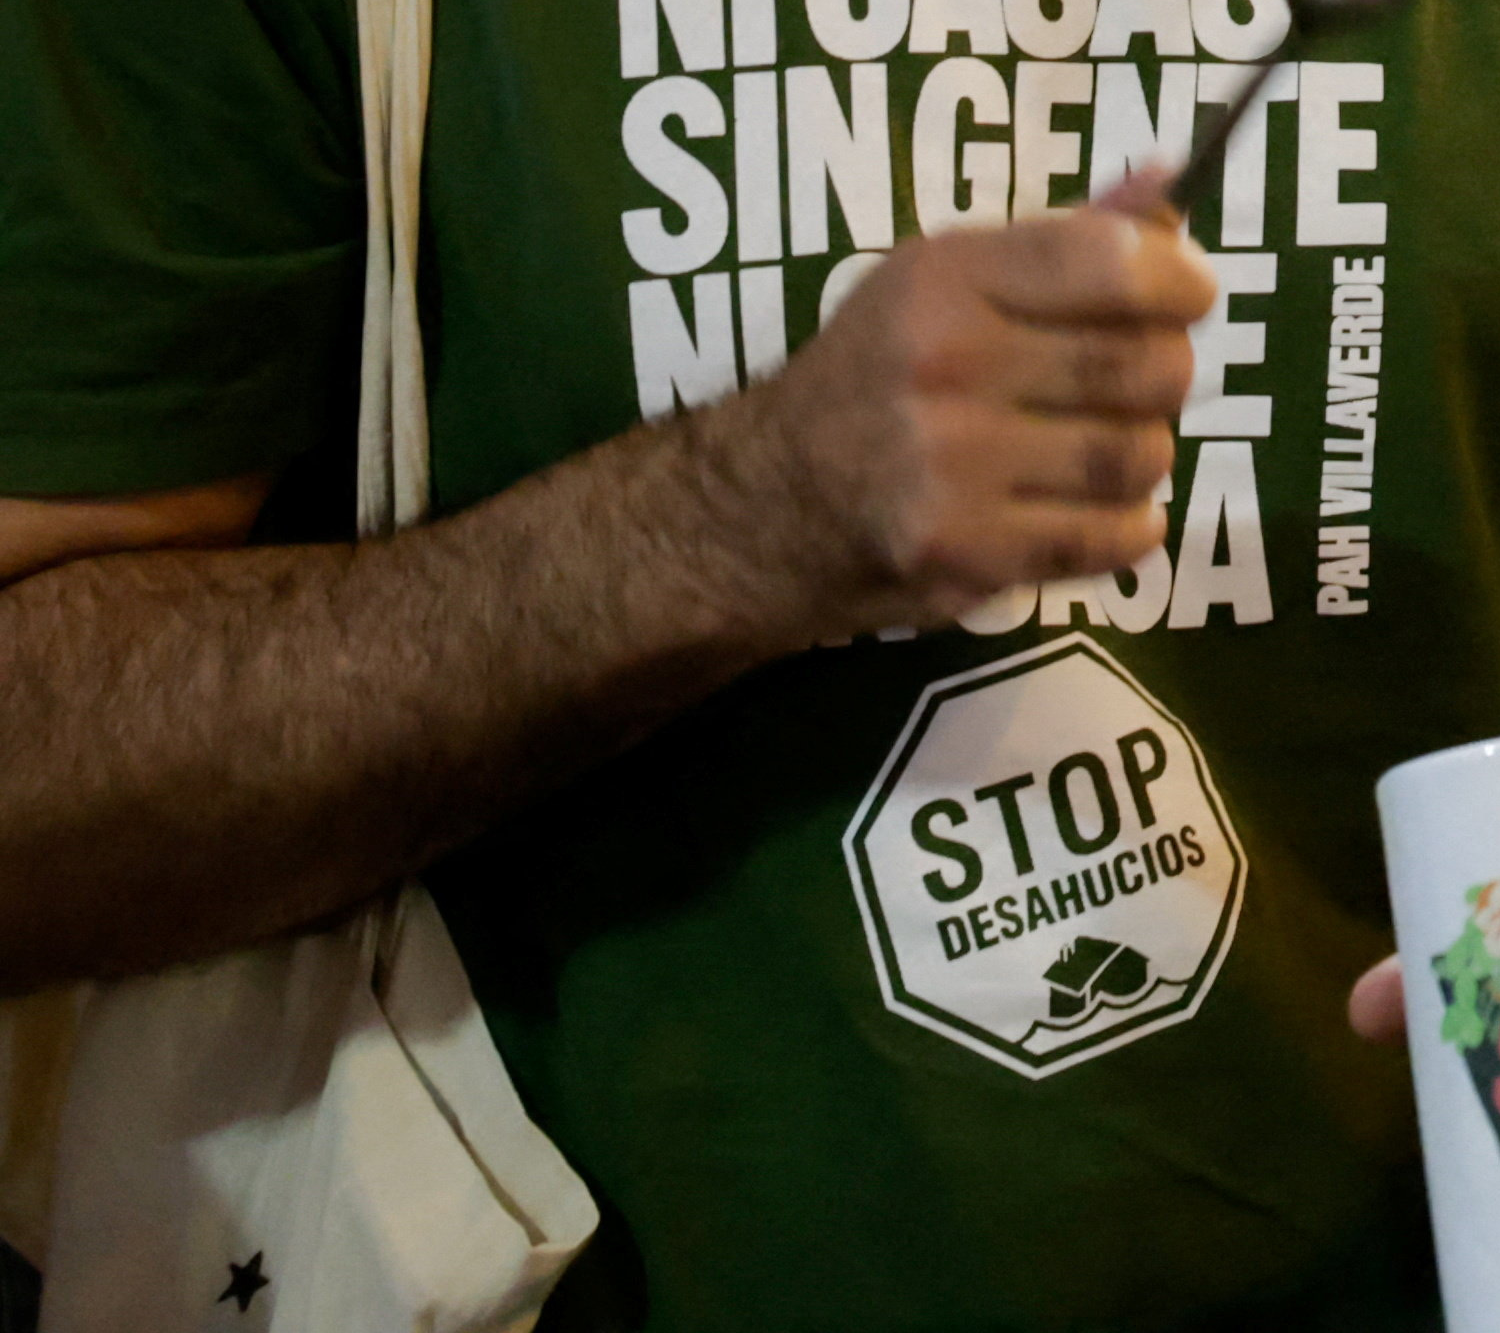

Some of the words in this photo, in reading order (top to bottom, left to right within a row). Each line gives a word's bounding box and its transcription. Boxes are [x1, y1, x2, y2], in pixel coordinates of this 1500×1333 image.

[620, 62, 895, 275] SIN
[912, 56, 1388, 249] GENTE
[1319, 255, 1386, 518] VILLAVERDE
[1316, 524, 1371, 616] PAH
[909, 726, 1168, 904] STOP
[935, 824, 1207, 963] DESAHUCIOS
